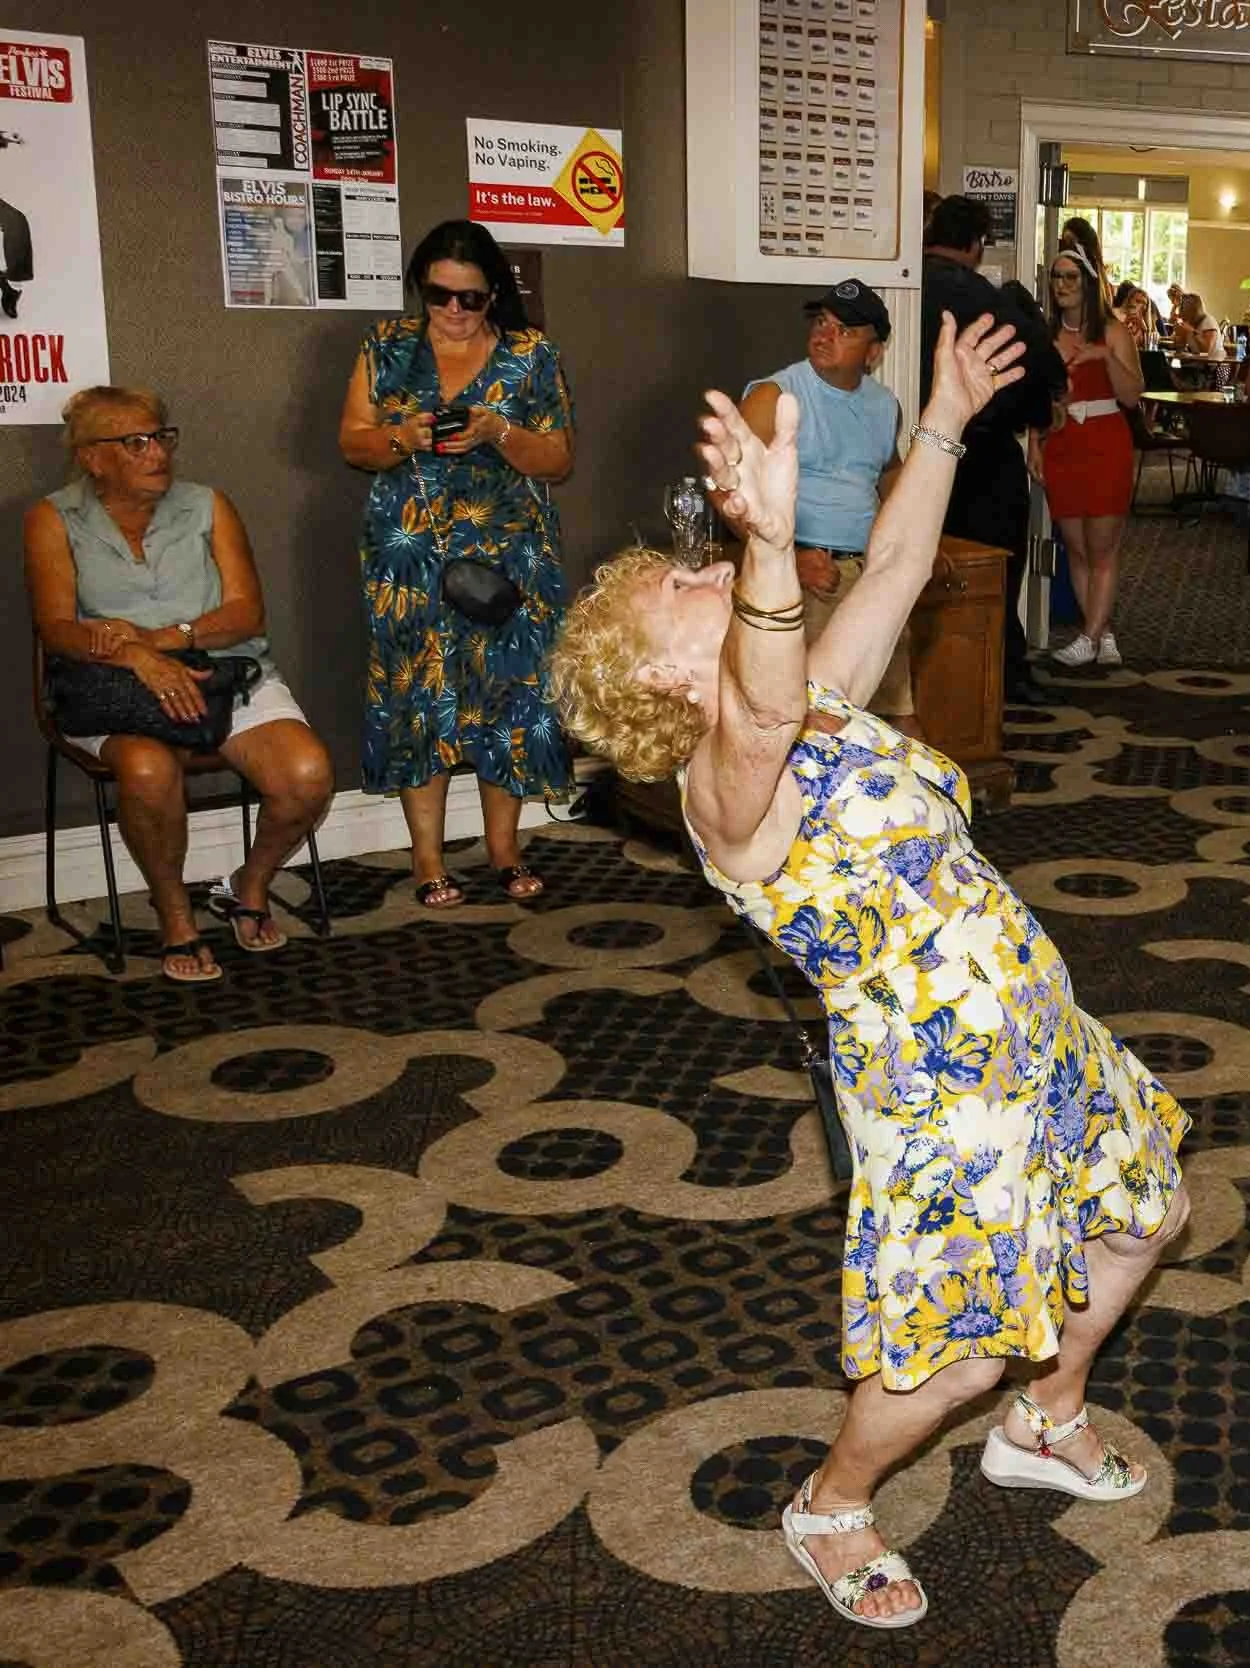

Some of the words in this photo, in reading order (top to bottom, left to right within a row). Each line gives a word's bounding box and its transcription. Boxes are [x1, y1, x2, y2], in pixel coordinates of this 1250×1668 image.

[211, 54, 292, 70] ENTERTAINMENT
[247, 48, 282, 60] ELVIS
[0, 55, 66, 89] ELVIS
[10, 85, 54, 99] FESTIVAL
[322, 93, 343, 110] LIP
[346, 93, 378, 110] SYNC
[330, 109, 388, 131] BATTLE
[474, 136, 494, 150] No
[497, 138, 563, 157] Smoking.
[475, 152, 495, 166] No
[498, 153, 551, 171] Vaping.
[242, 180, 286, 195] ELVIS
[966, 170, 1013, 189] Bistro
[224, 191, 264, 204] BISTRO
[267, 193, 305, 205] HOURS
[476, 190, 499, 204] It's
[501, 192, 526, 206] the
[528, 193, 557, 208] law.
[0, 333, 69, 384] ROCK
